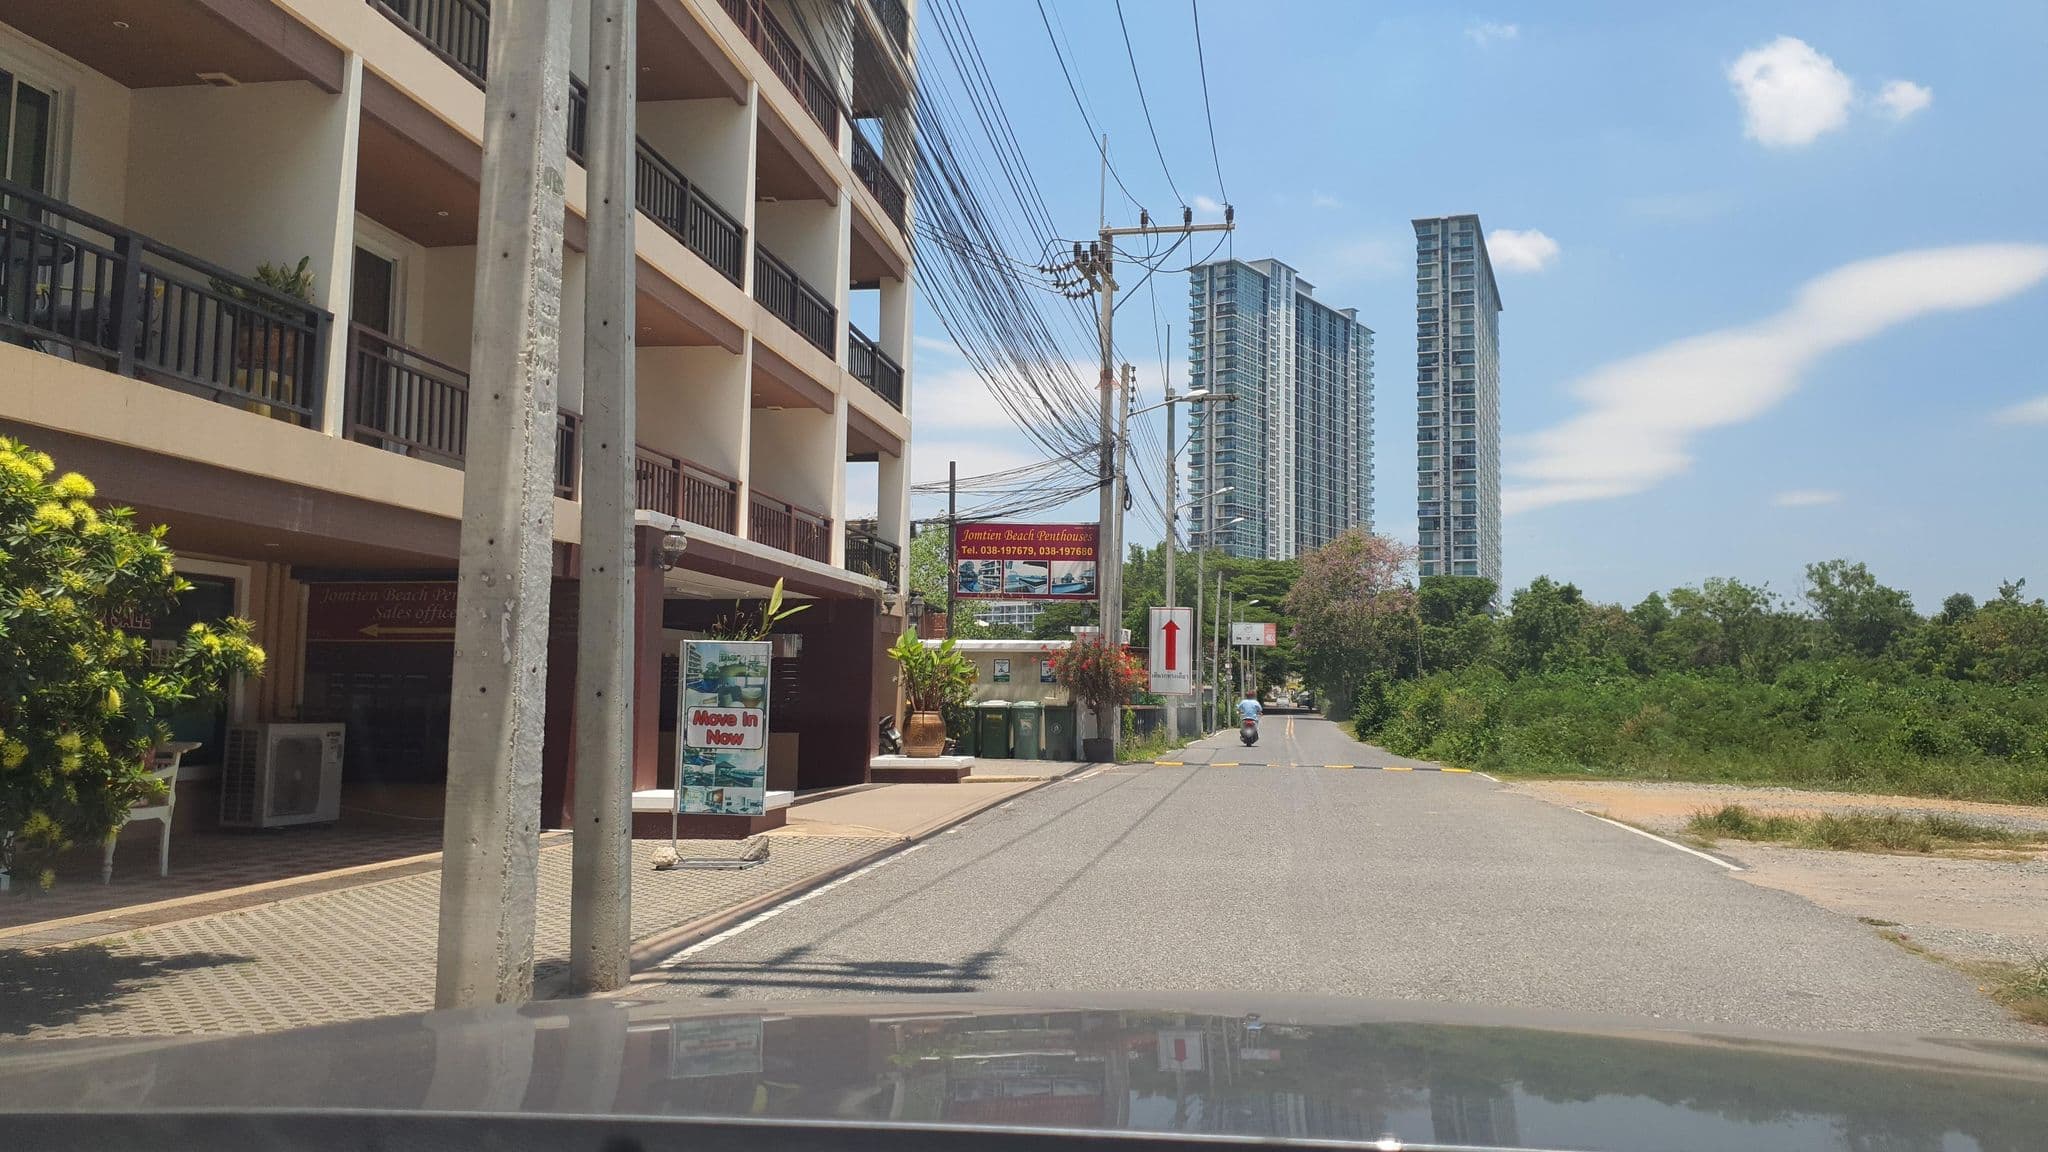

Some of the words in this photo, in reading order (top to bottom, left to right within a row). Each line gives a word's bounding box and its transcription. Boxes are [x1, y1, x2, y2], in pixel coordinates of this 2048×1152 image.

[961, 529, 1001, 542] Jomtien
[1004, 528, 1035, 542] Beach
[1037, 529, 1093, 542] Penthouses
[961, 545, 979, 555] Tel.
[980, 546, 1037, 557] 038-197679,
[1039, 547, 1093, 556] 038-197680
[321, 587, 379, 604] Jomtien
[382, 585, 428, 603] Beach
[374, 607, 412, 621] Sales
[693, 710, 738, 727] Move
[742, 711, 759, 727] In
[706, 729, 745, 746] Now
